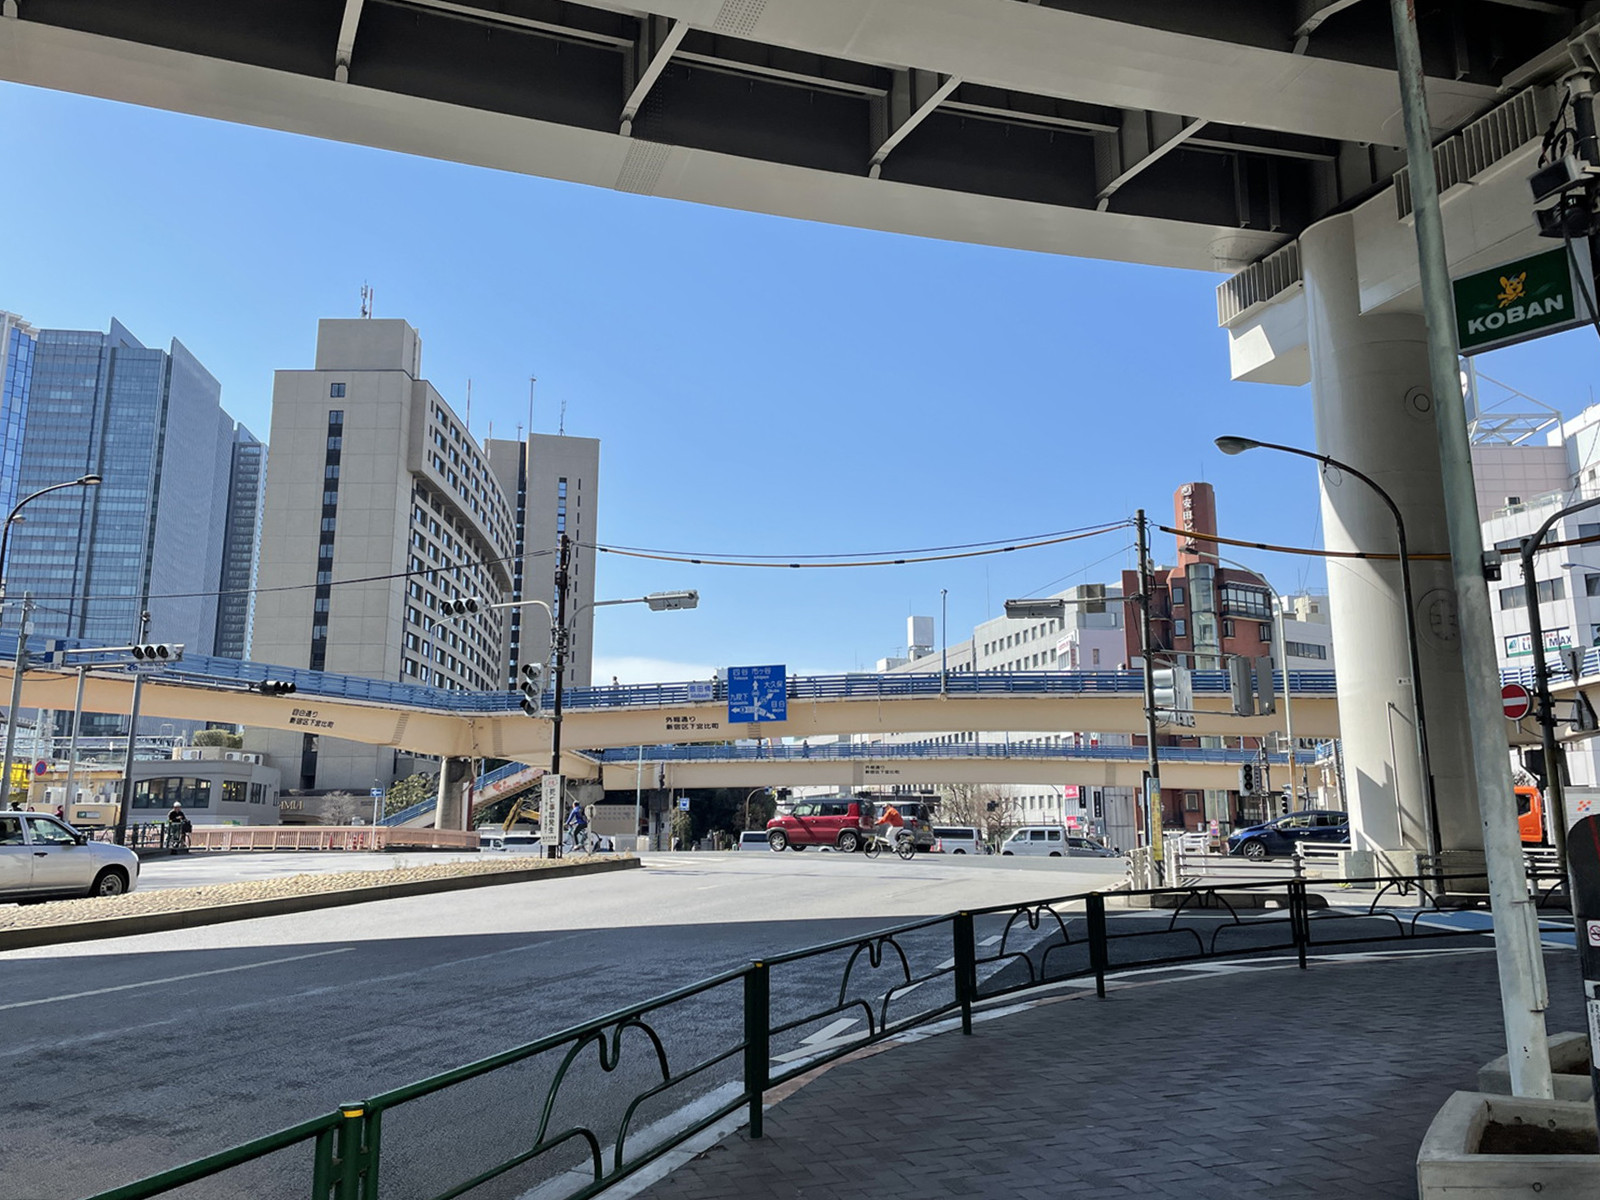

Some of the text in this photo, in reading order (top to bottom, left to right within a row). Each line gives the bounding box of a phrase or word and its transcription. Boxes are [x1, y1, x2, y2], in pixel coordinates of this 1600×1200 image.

[1467, 294, 1564, 335] KOBAN
[764, 680, 783, 688] 大久保
[730, 693, 748, 701] 九段下
[771, 700, 785, 708] 目白
[291, 708, 318, 718] 目白通り
[289, 717, 335, 728] 新宿区下宮比町
